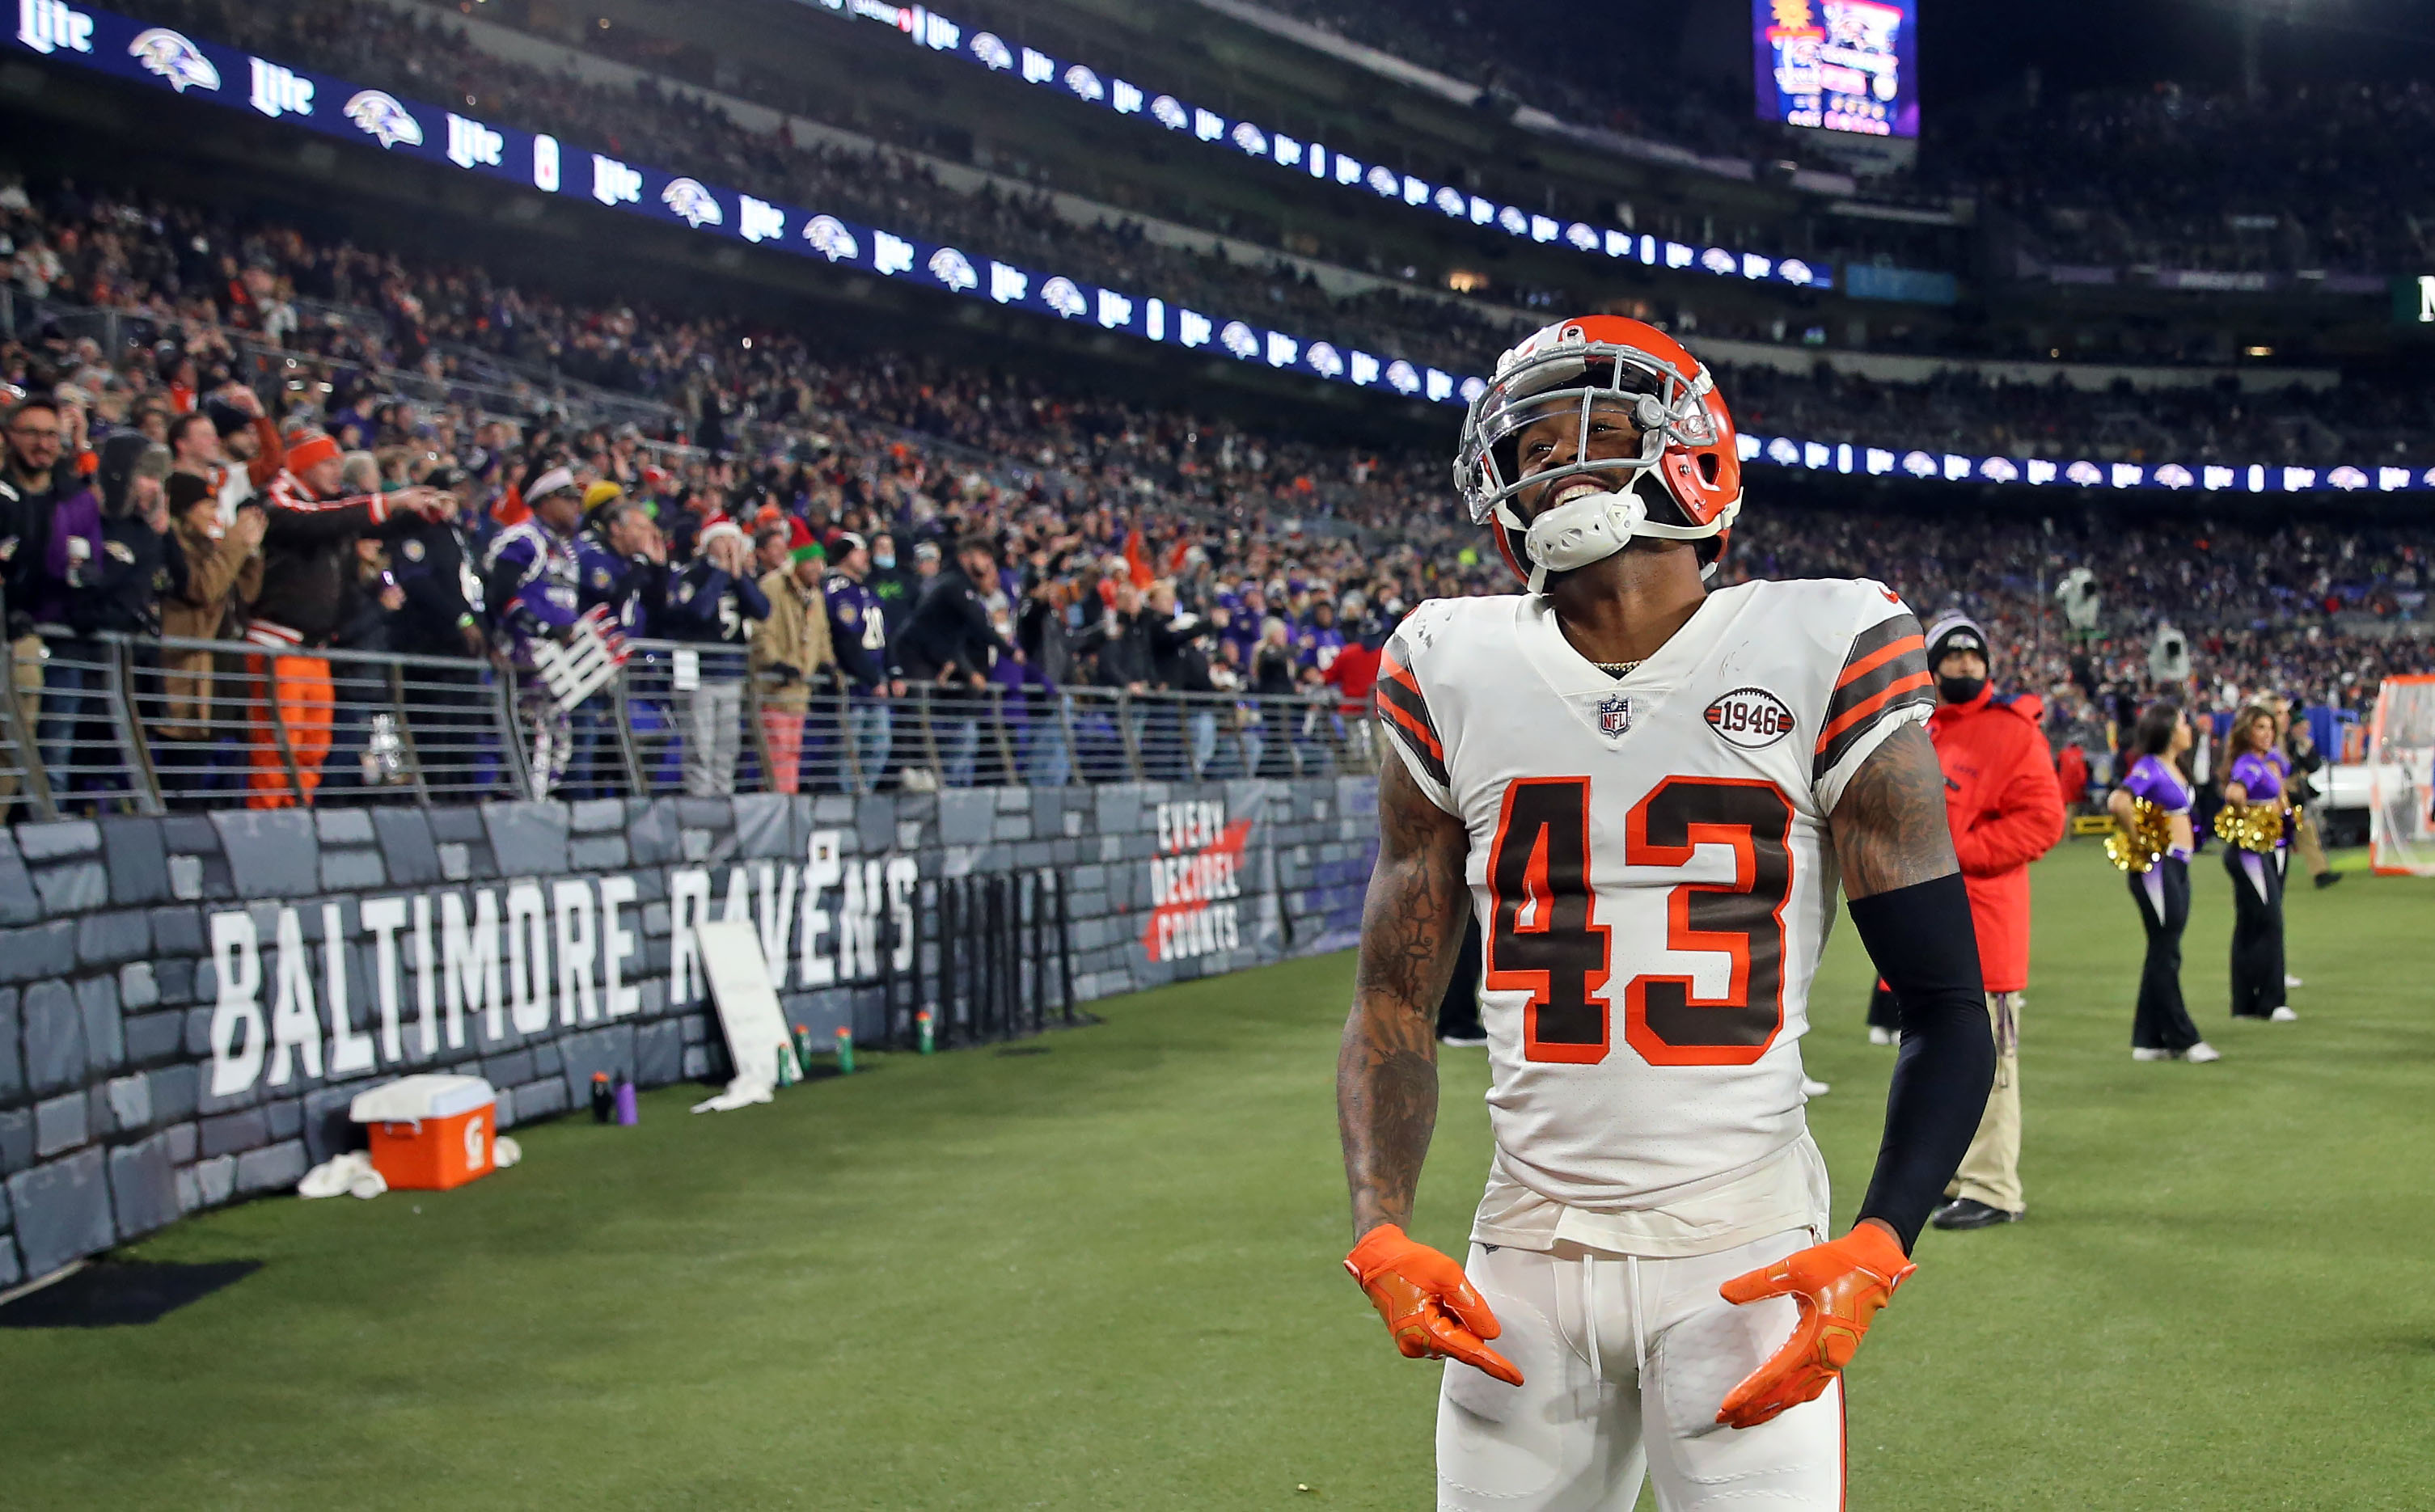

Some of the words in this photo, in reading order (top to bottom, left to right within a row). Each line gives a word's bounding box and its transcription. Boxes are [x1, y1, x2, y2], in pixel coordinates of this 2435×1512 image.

[16, 0, 94, 54] Lite
[248, 57, 315, 118] Lite
[1602, 713, 1625, 730] NFL
[1722, 700, 1778, 736] 1946
[1486, 775, 1795, 1066] 43
[209, 876, 642, 1097] BALTIMORE
